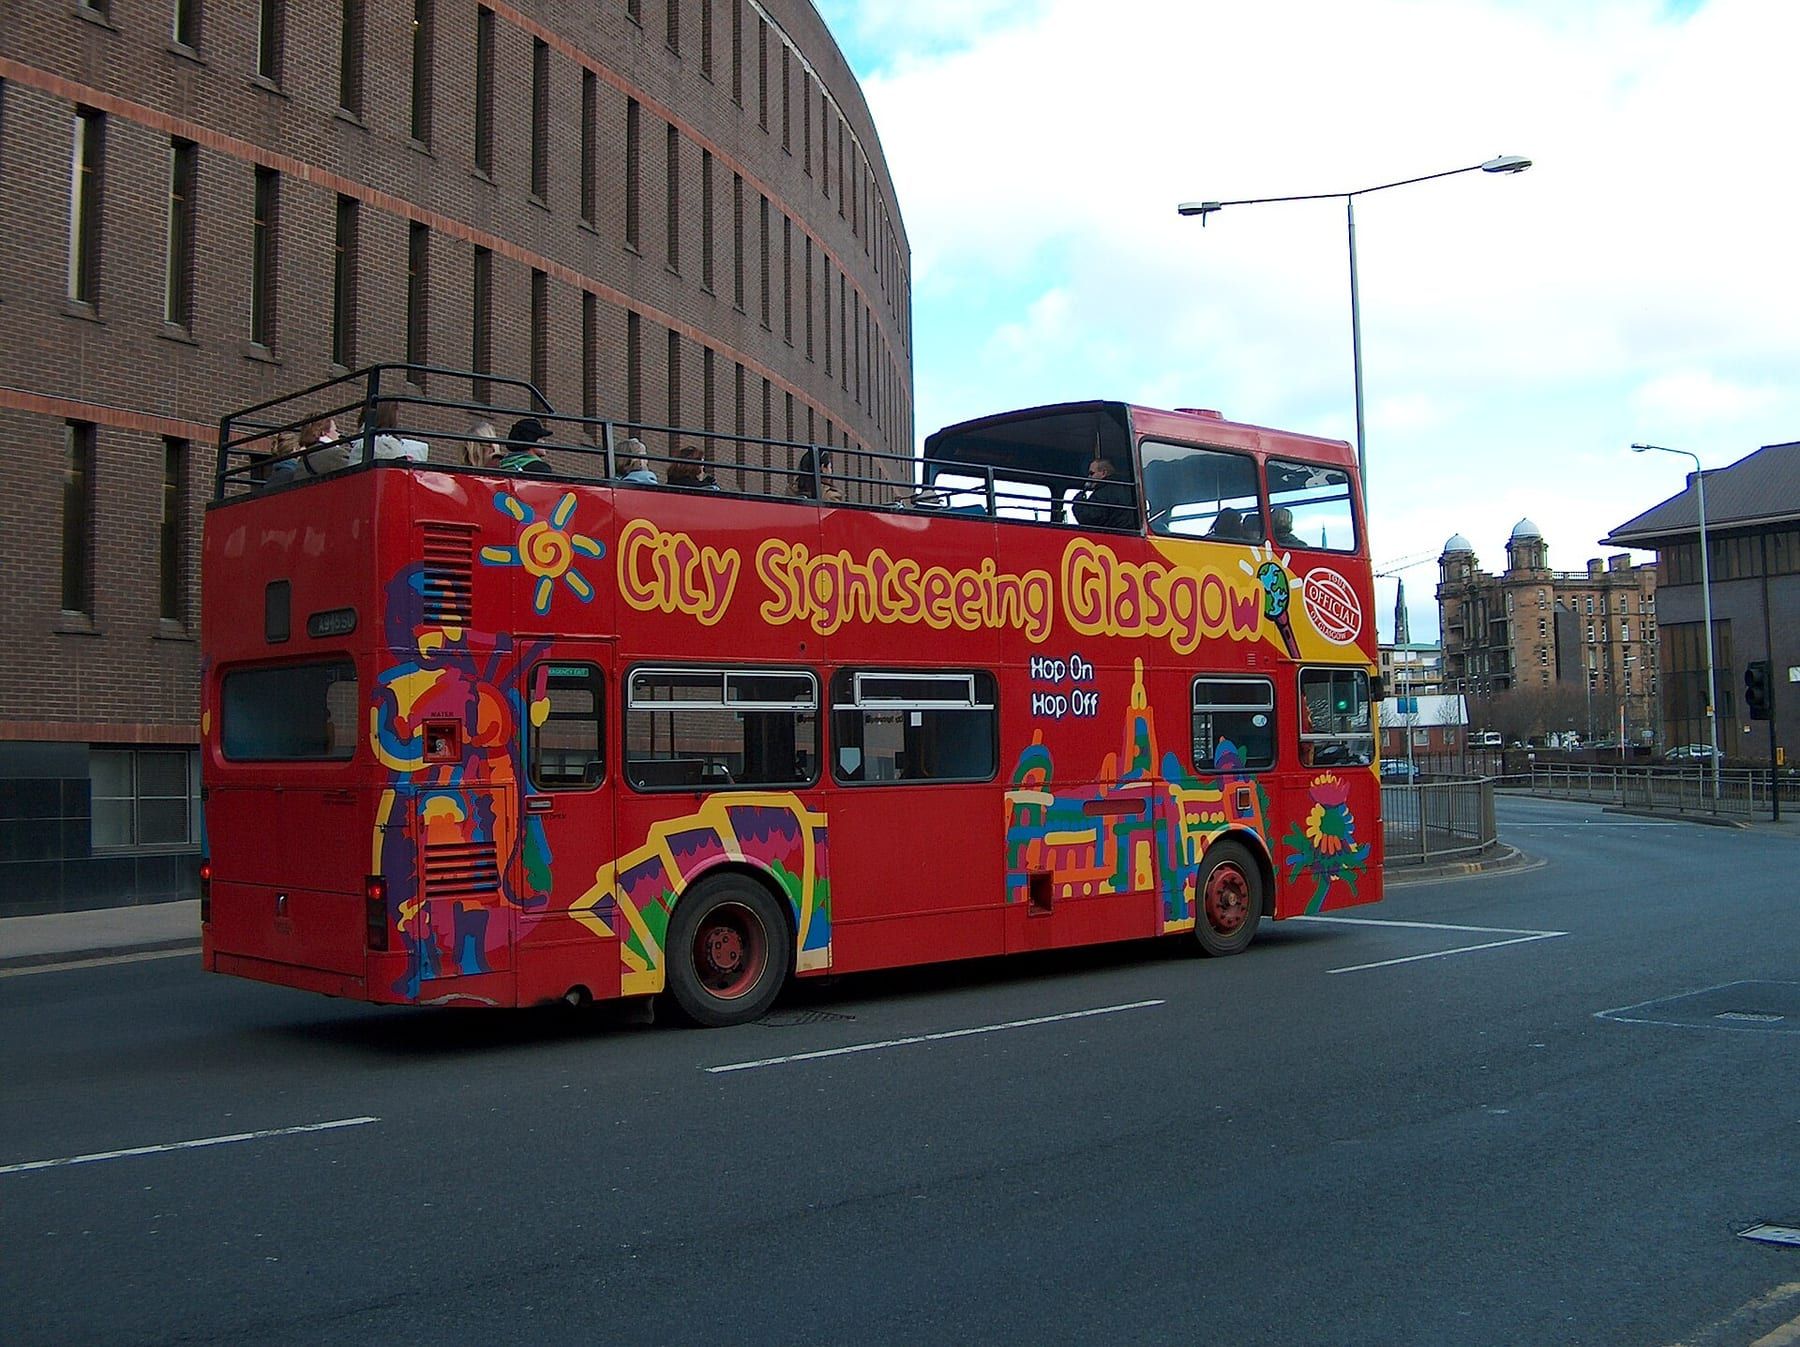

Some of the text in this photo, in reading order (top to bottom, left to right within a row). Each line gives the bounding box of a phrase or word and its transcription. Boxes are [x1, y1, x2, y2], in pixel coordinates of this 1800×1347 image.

[617, 519, 1265, 655] City Sightseeing Glasgow
[1328, 573, 1347, 590] TOUR
[1309, 585, 1356, 628] OFFICIAL
[1030, 654, 1093, 683] Hop On
[1032, 690, 1098, 718] Hop Off
